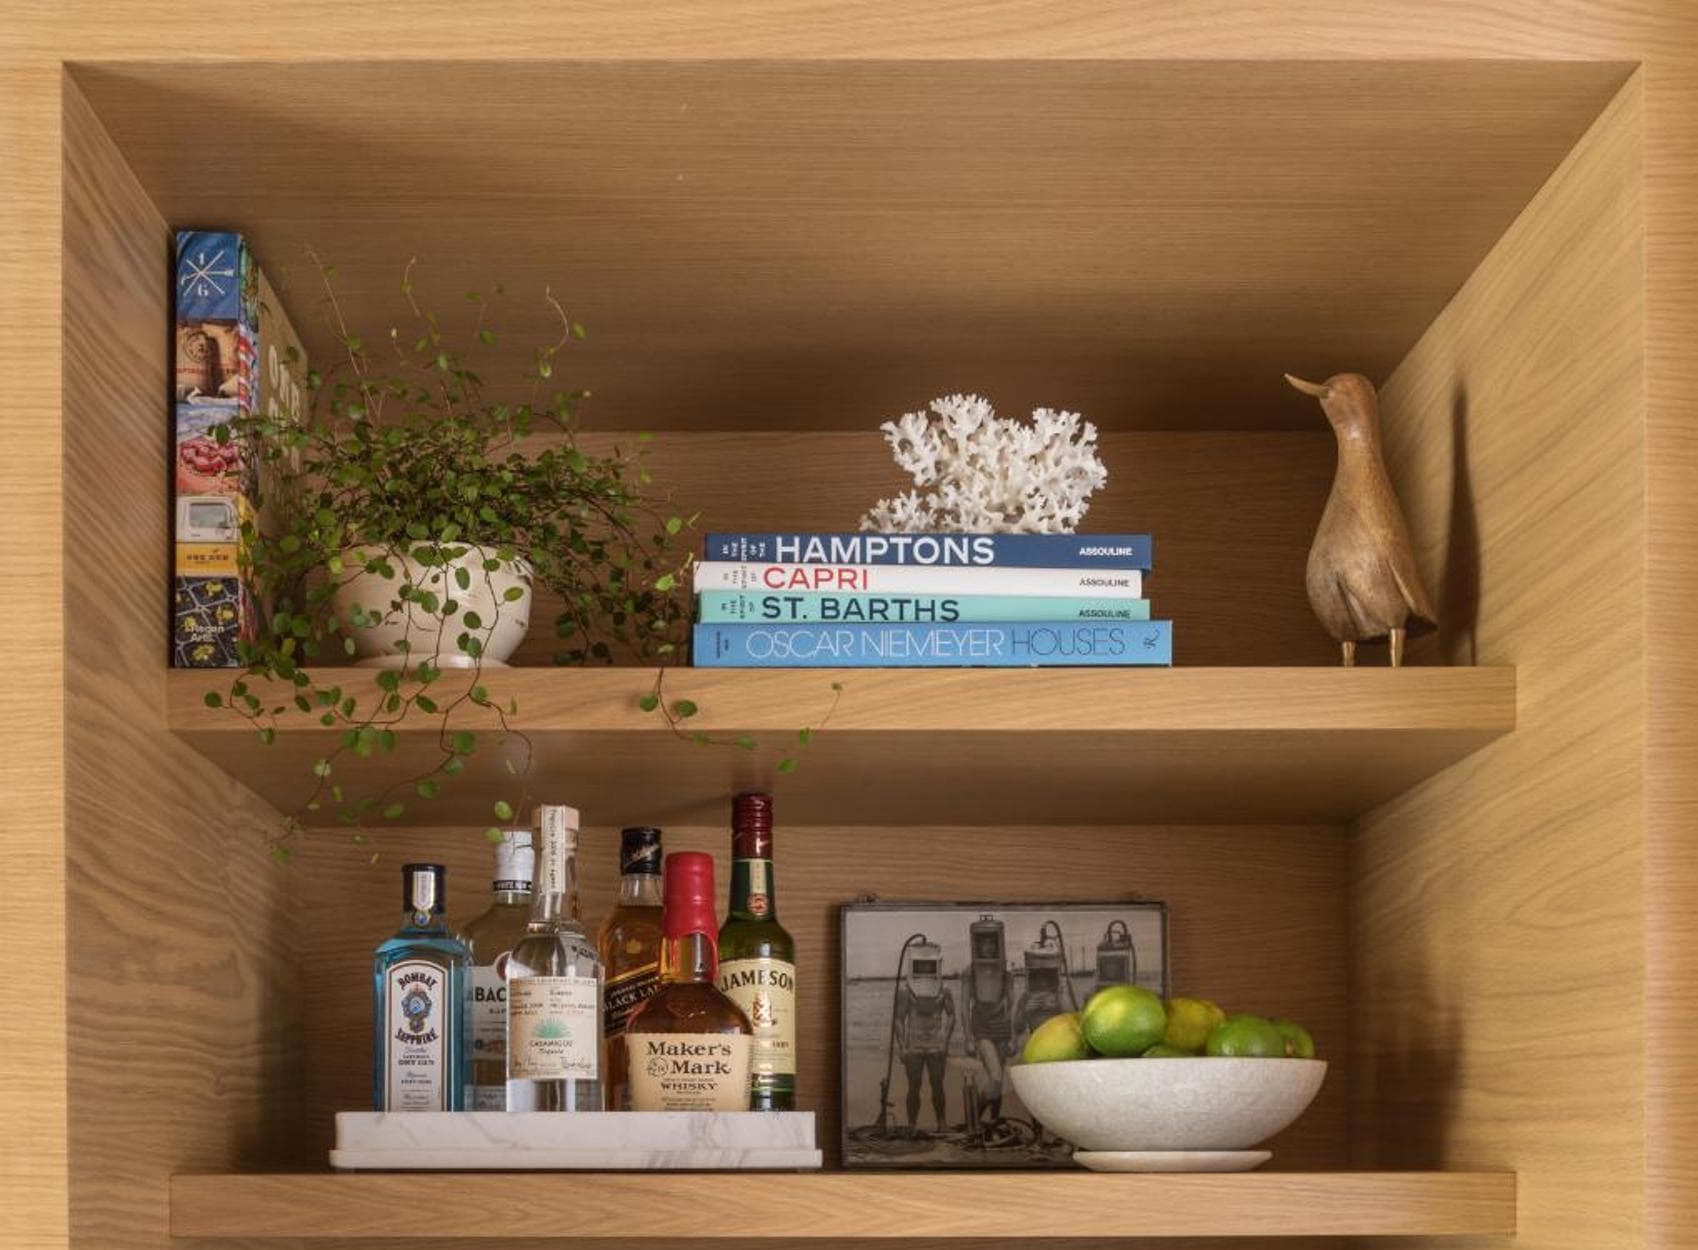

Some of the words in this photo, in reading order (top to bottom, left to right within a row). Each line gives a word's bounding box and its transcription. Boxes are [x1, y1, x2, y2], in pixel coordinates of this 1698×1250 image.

[776, 535, 995, 565] HAMPTONS
[1079, 547, 1134, 556] ASSOULINE
[763, 566, 868, 591] CAPRI
[1079, 578, 1131, 588] ASSOULINE
[762, 596, 808, 620] ST.
[821, 597, 960, 622] BARTHS
[1079, 609, 1132, 619] ASSOULINE
[746, 629, 854, 659] OSCAR
[861, 629, 1005, 658] NIEMEYER
[1011, 627, 1126, 657] HOUSES
[397, 971, 439, 991] BOMBAY
[721, 968, 794, 992] JAMESON
[395, 1027, 439, 1045] SAPPHIRE
[646, 1041, 732, 1057] Maker's
[670, 1060, 732, 1075] Mark
[660, 1082, 719, 1091] WHISKY
